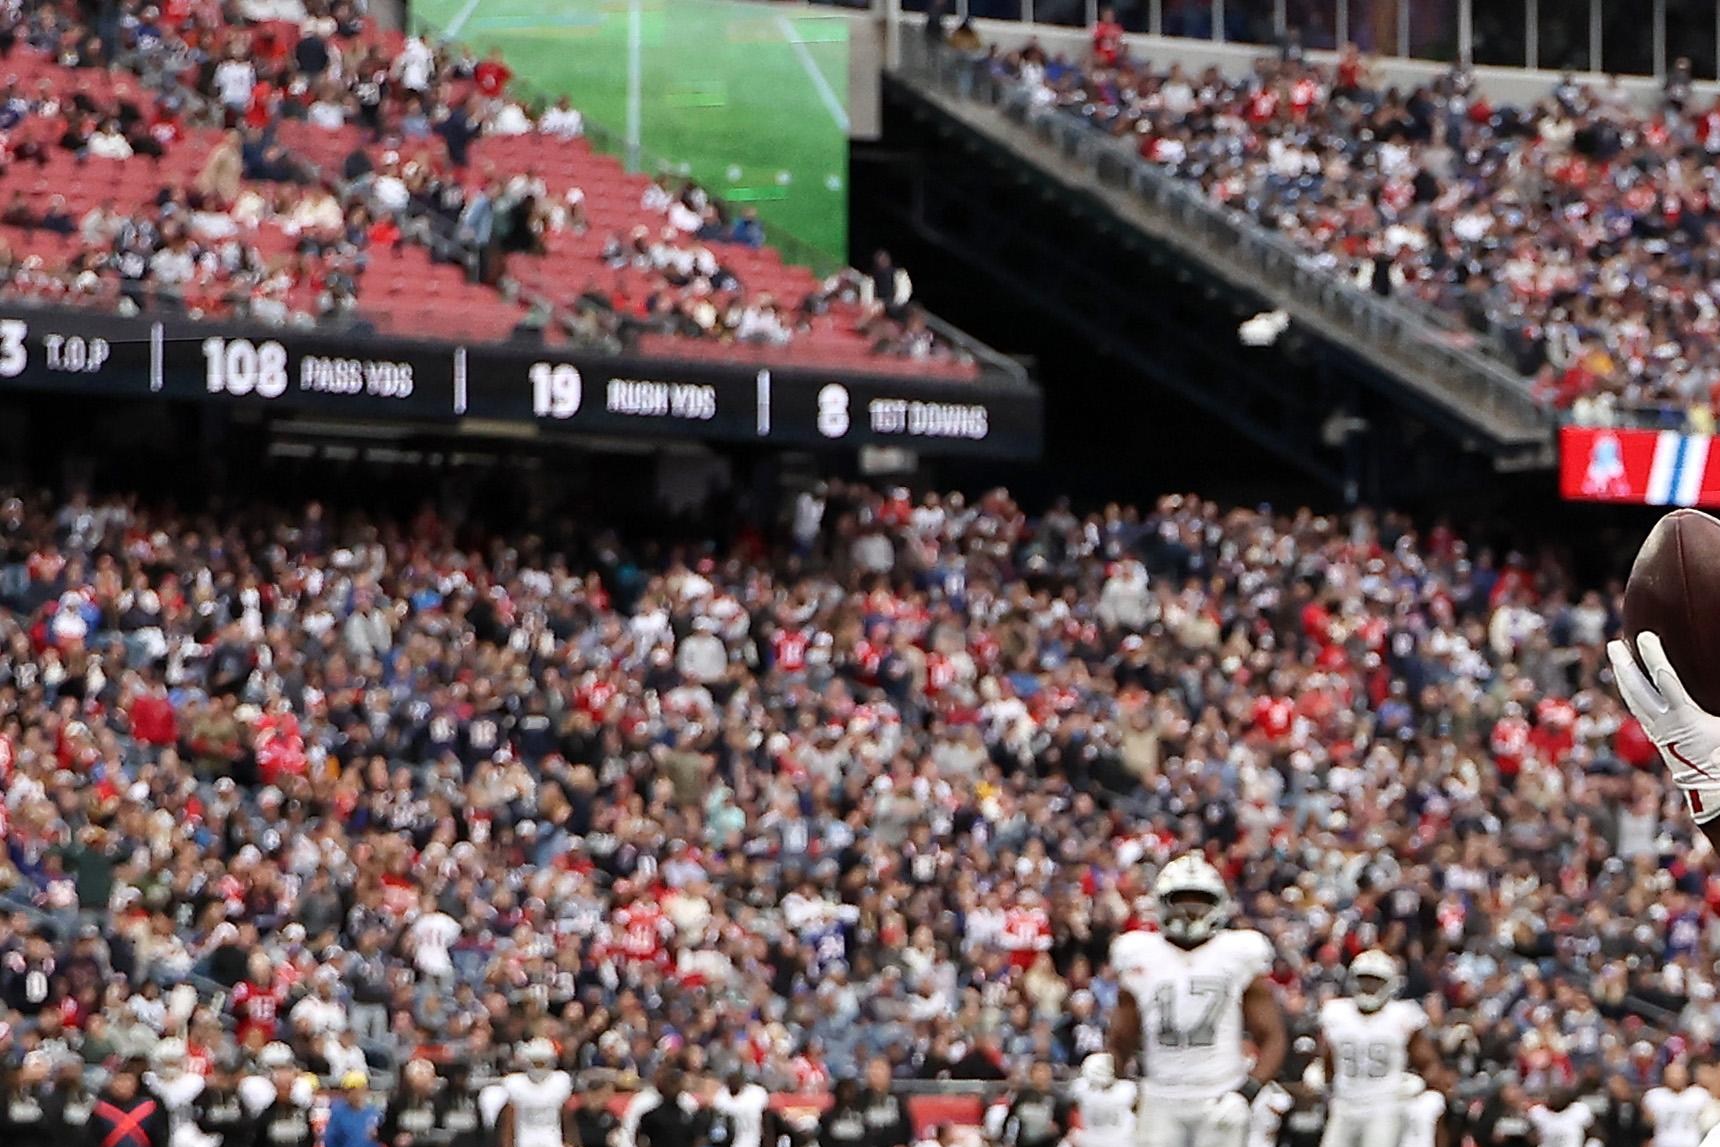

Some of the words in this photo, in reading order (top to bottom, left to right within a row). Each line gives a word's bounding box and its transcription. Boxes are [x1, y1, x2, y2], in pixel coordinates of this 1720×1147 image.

[203, 336, 288, 398] 108
[300, 354, 363, 395] PASS
[364, 360, 414, 398] YDS
[528, 361, 582, 420] 19
[607, 378, 669, 417] RUSH
[670, 383, 716, 421] YDS
[817, 382, 850, 439] 8
[907, 400, 989, 440] DOWNS
[1153, 971, 1233, 1047] 17
